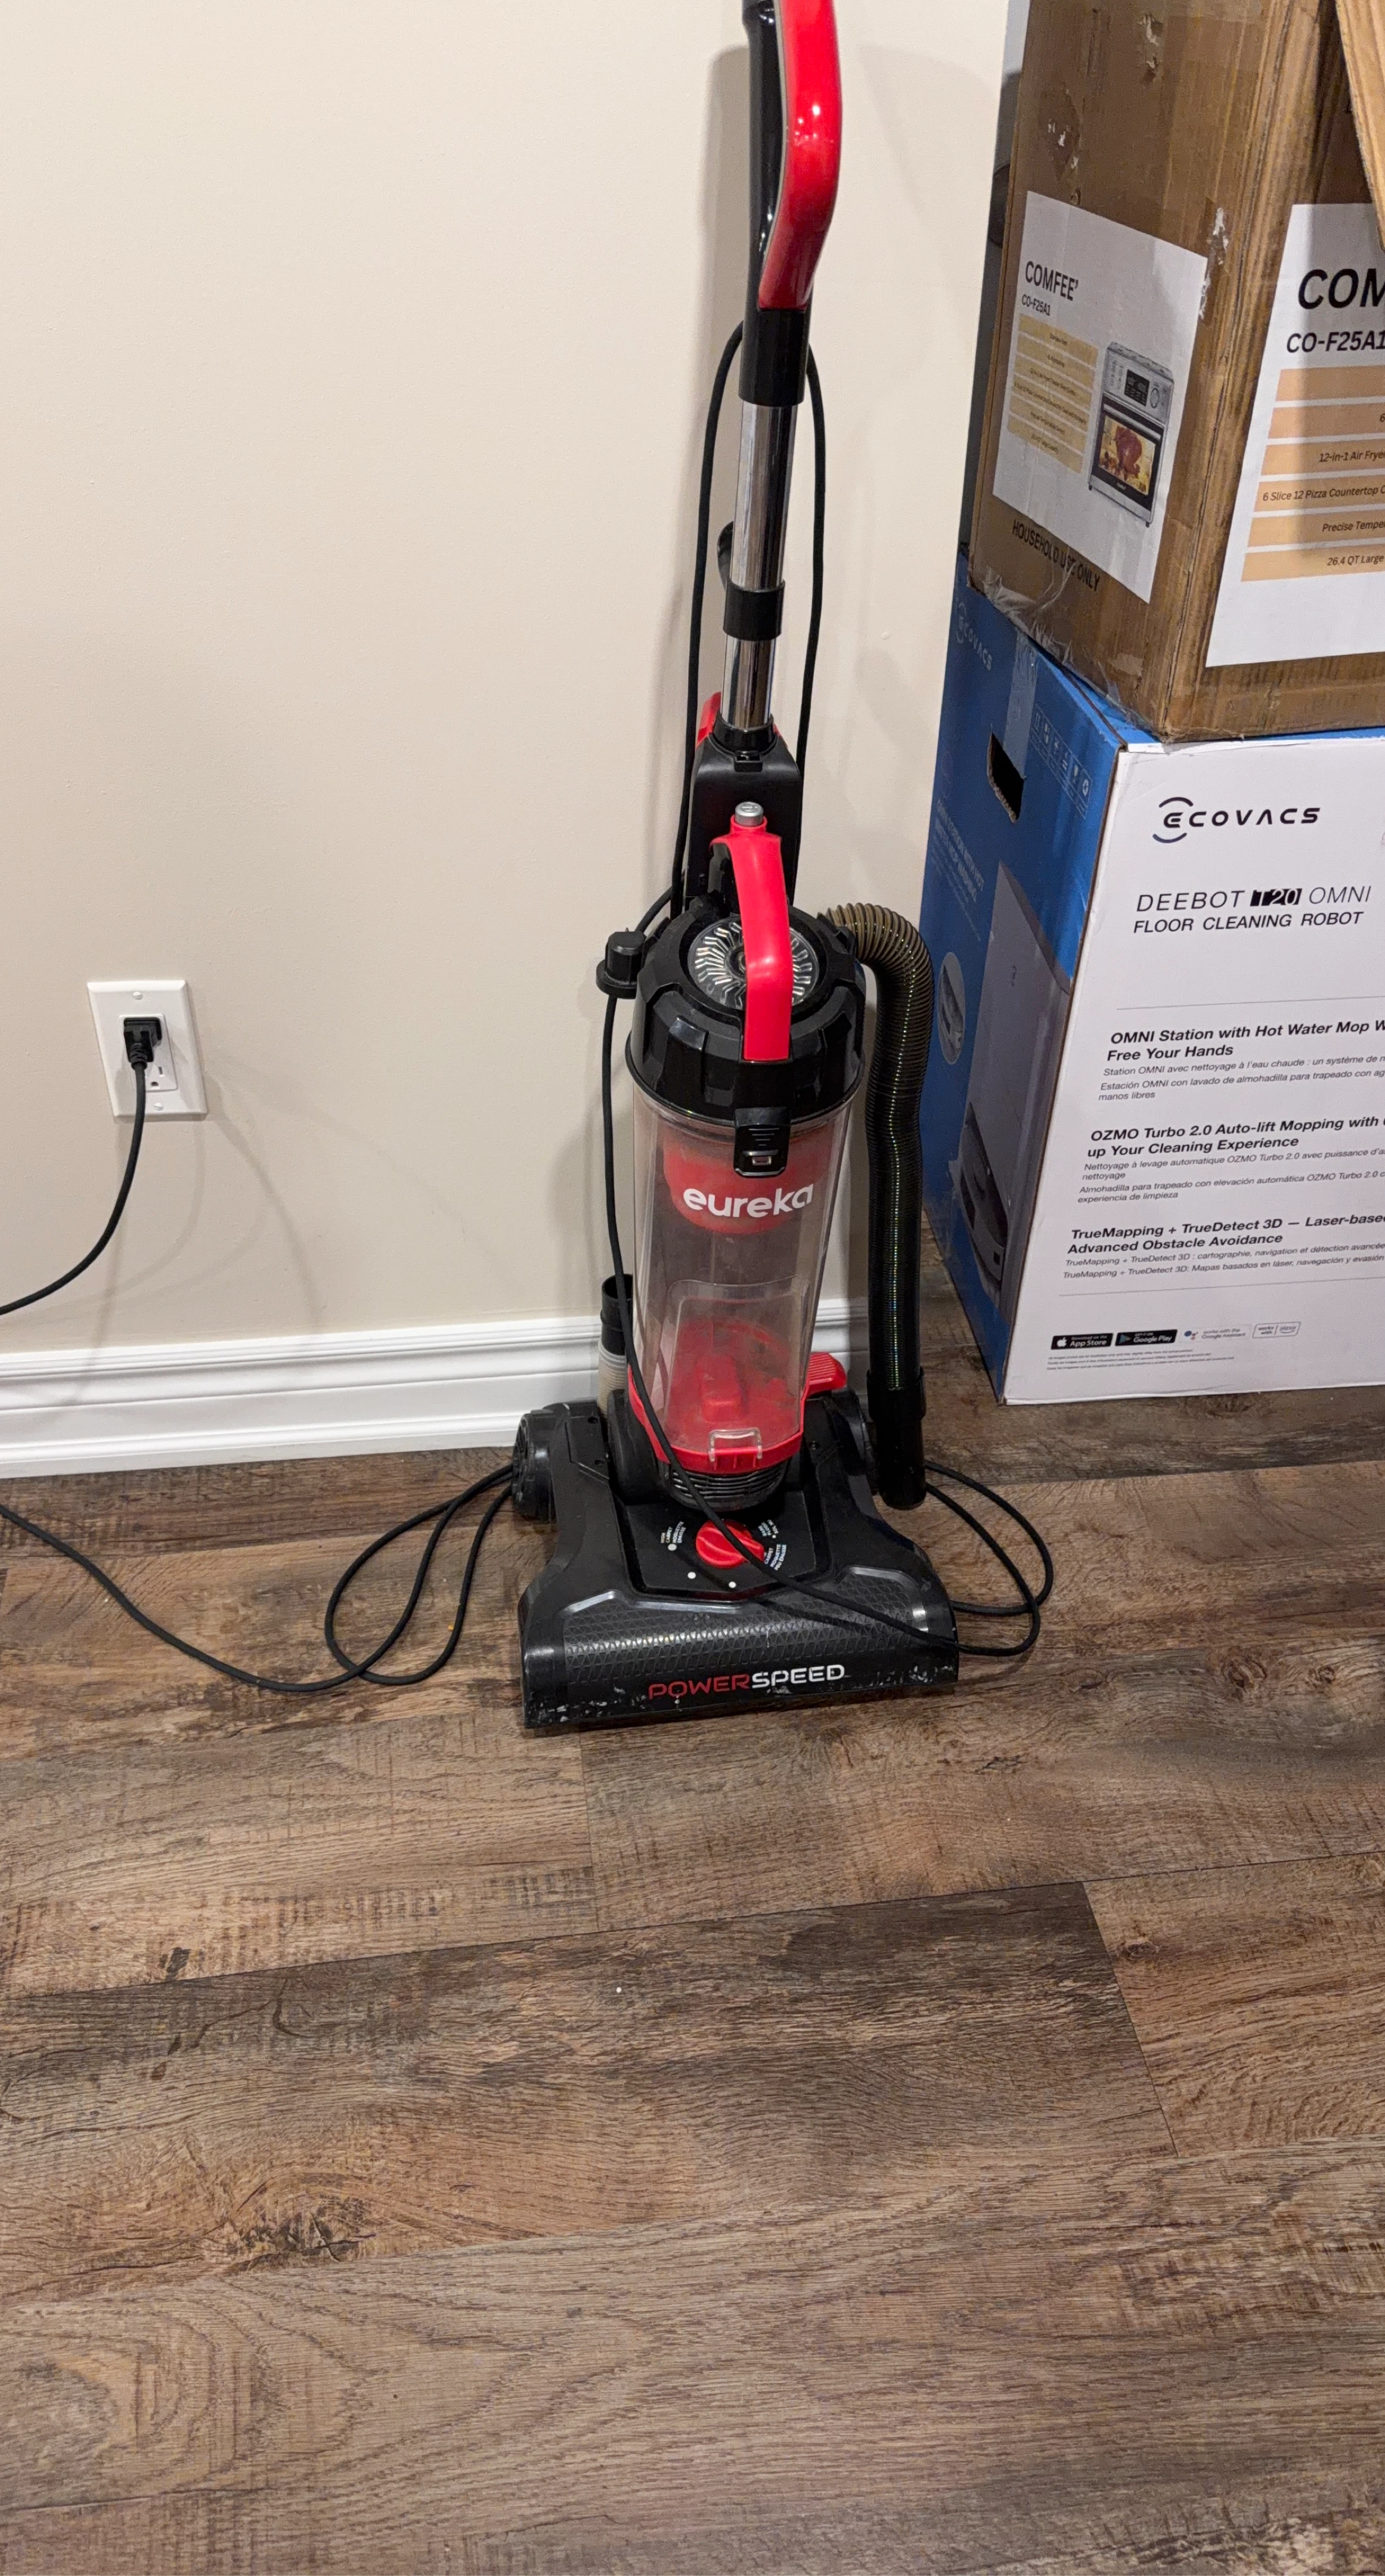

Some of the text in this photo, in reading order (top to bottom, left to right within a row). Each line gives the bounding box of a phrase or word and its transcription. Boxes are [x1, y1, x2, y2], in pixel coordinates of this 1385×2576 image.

[1025, 261, 1079, 301] COMFEE'
[1022, 294, 1051, 316] CO-F25A1
[1287, 330, 1385, 353] CO-F25A1
[1319, 452, 1349, 462] 12-in-1
[1350, 451, 1364, 460] Air
[1263, 492, 1269, 501] 6
[1270, 491, 1292, 501] Slice
[1293, 491, 1304, 499] 12
[1305, 490, 1327, 499] Pizza
[1329, 487, 1378, 497] Countertop
[1322, 522, 1353, 532] Precise
[1012, 519, 1059, 563] HOUSEHOLD
[1077, 564, 1100, 592] ONLY
[1327, 555, 1384, 566] 26.4 QT Large
[1136, 886, 1371, 912] DEEBOT T20 OMNI
[1133, 912, 1364, 933] FLOOR CLEANING ROBOT
[1111, 1031, 1155, 1044] OMNI
[1159, 1029, 1213, 1042] Station
[1219, 1026, 1250, 1039] with
[1255, 1024, 1283, 1037] Hot
[1288, 1023, 1333, 1036] Water
[1336, 1021, 1369, 1035] Mop
[1107, 1045, 1234, 1061] Free Your Hands
[1103, 1067, 1136, 1076] Station
[1138, 1066, 1165, 1075] OMNI
[1191, 1063, 1237, 1072] nettoyage
[1271, 1059, 1305, 1067] chaude
[1326, 1056, 1364, 1066] système
[1366, 1055, 1378, 1063] de
[1101, 1081, 1139, 1091] Estación
[1142, 1080, 1169, 1089] OMNI
[1190, 1077, 1220, 1086] lavado
[1237, 1074, 1287, 1083] almohadilla
[1289, 1074, 1310, 1082] para
[1313, 1071, 1352, 1080] trapeado
[1091, 1129, 1139, 1141] OZMO
[1144, 1126, 1185, 1138] Turbo
[1189, 1125, 1212, 1137] 2.0
[1215, 1122, 1276, 1135] Auto-lift
[1279, 1119, 1344, 1132] Mopping
[1349, 1116, 1379, 1128] with
[1087, 1138, 1299, 1159] up Your Cleaning Experience
[1084, 1162, 1129, 1171] Nettoyage
[1139, 1160, 1169, 1169] levage
[1170, 1157, 1225, 1166] automatique
[1227, 1154, 1257, 1163] OZMO
[1260, 1153, 1284, 1162] Turbo
[1324, 1149, 1368, 1159] puissance
[1079, 1184, 1129, 1193] Almohadilla
[1132, 1184, 1152, 1193] para
[1154, 1181, 1193, 1190] trapeado
[1213, 1178, 1254, 1186] elevación
[1256, 1175, 1305, 1184] automática
[1306, 1173, 1336, 1181] OZMO
[1082, 1172, 1126, 1181] nettoyage
[683, 1184, 814, 1218] eureka
[1077, 1194, 1127, 1204] experiencia
[1142, 1192, 1178, 1201] limpieza
[1071, 1226, 1164, 1239] TrueMapping
[1182, 1219, 1260, 1234] TrueDetect
[1263, 1219, 1282, 1229] 3D
[1305, 1214, 1385, 1227] Laser-base
[1067, 1235, 1283, 1254] Advanced Obstacle Avoidance
[1063, 1270, 1117, 1278] TrueMapping
[1128, 1267, 1173, 1275] TrueDetect
[1191, 1264, 1220, 1272] Mapas
[1222, 1262, 1258, 1270] basados
[1272, 1259, 1293, 1268] láser,
[1296, 1256, 1343, 1266] navegación
[1352, 1254, 1384, 1262] evasión
[1065, 1258, 1120, 1267] TrueMapping
[1131, 1255, 1176, 1263] TrueDetect
[1197, 1250, 1252, 1260] cartographie,
[1254, 1247, 1297, 1256] navigation
[1310, 1244, 1349, 1253] détection
[649, 1664, 845, 1699] POWERSPEED
